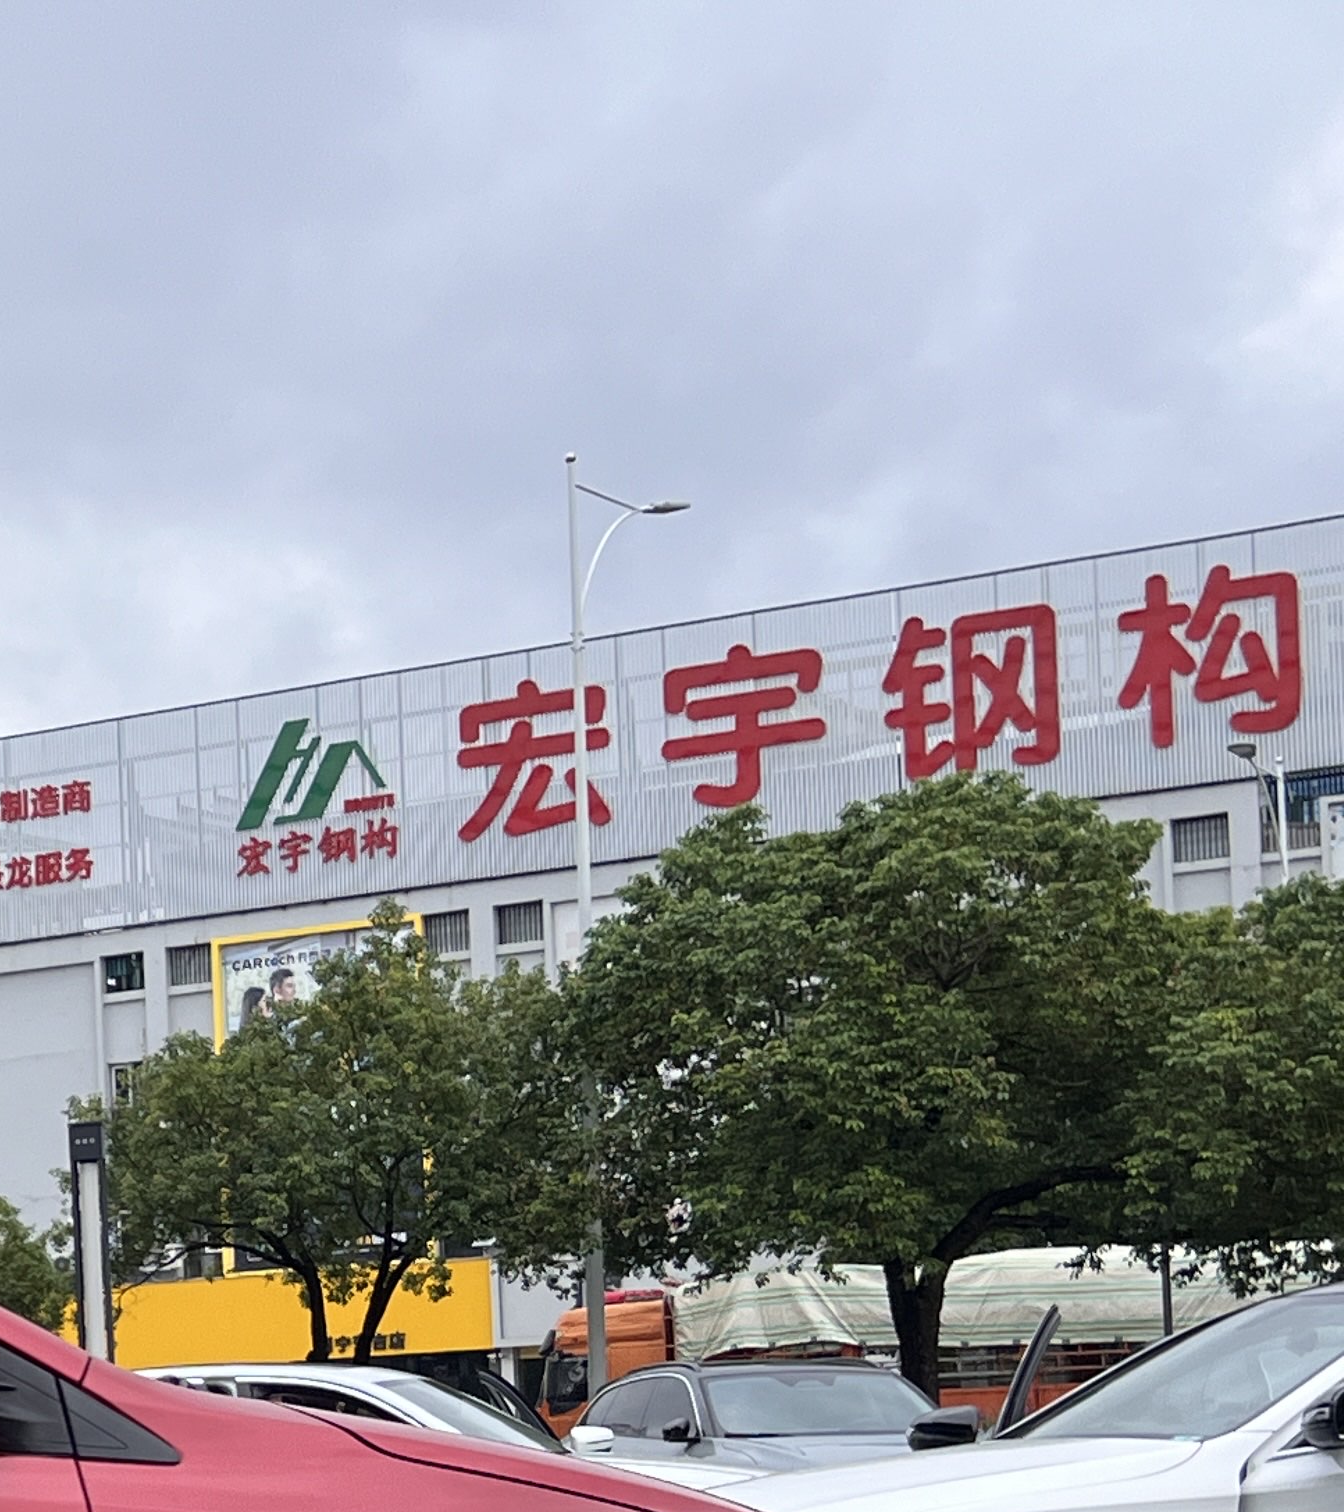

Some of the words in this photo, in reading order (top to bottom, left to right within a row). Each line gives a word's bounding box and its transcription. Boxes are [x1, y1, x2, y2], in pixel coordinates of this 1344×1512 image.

[457, 564, 1303, 843] 宏宇钢构
[236, 817, 400, 878] 宏宇钢构
